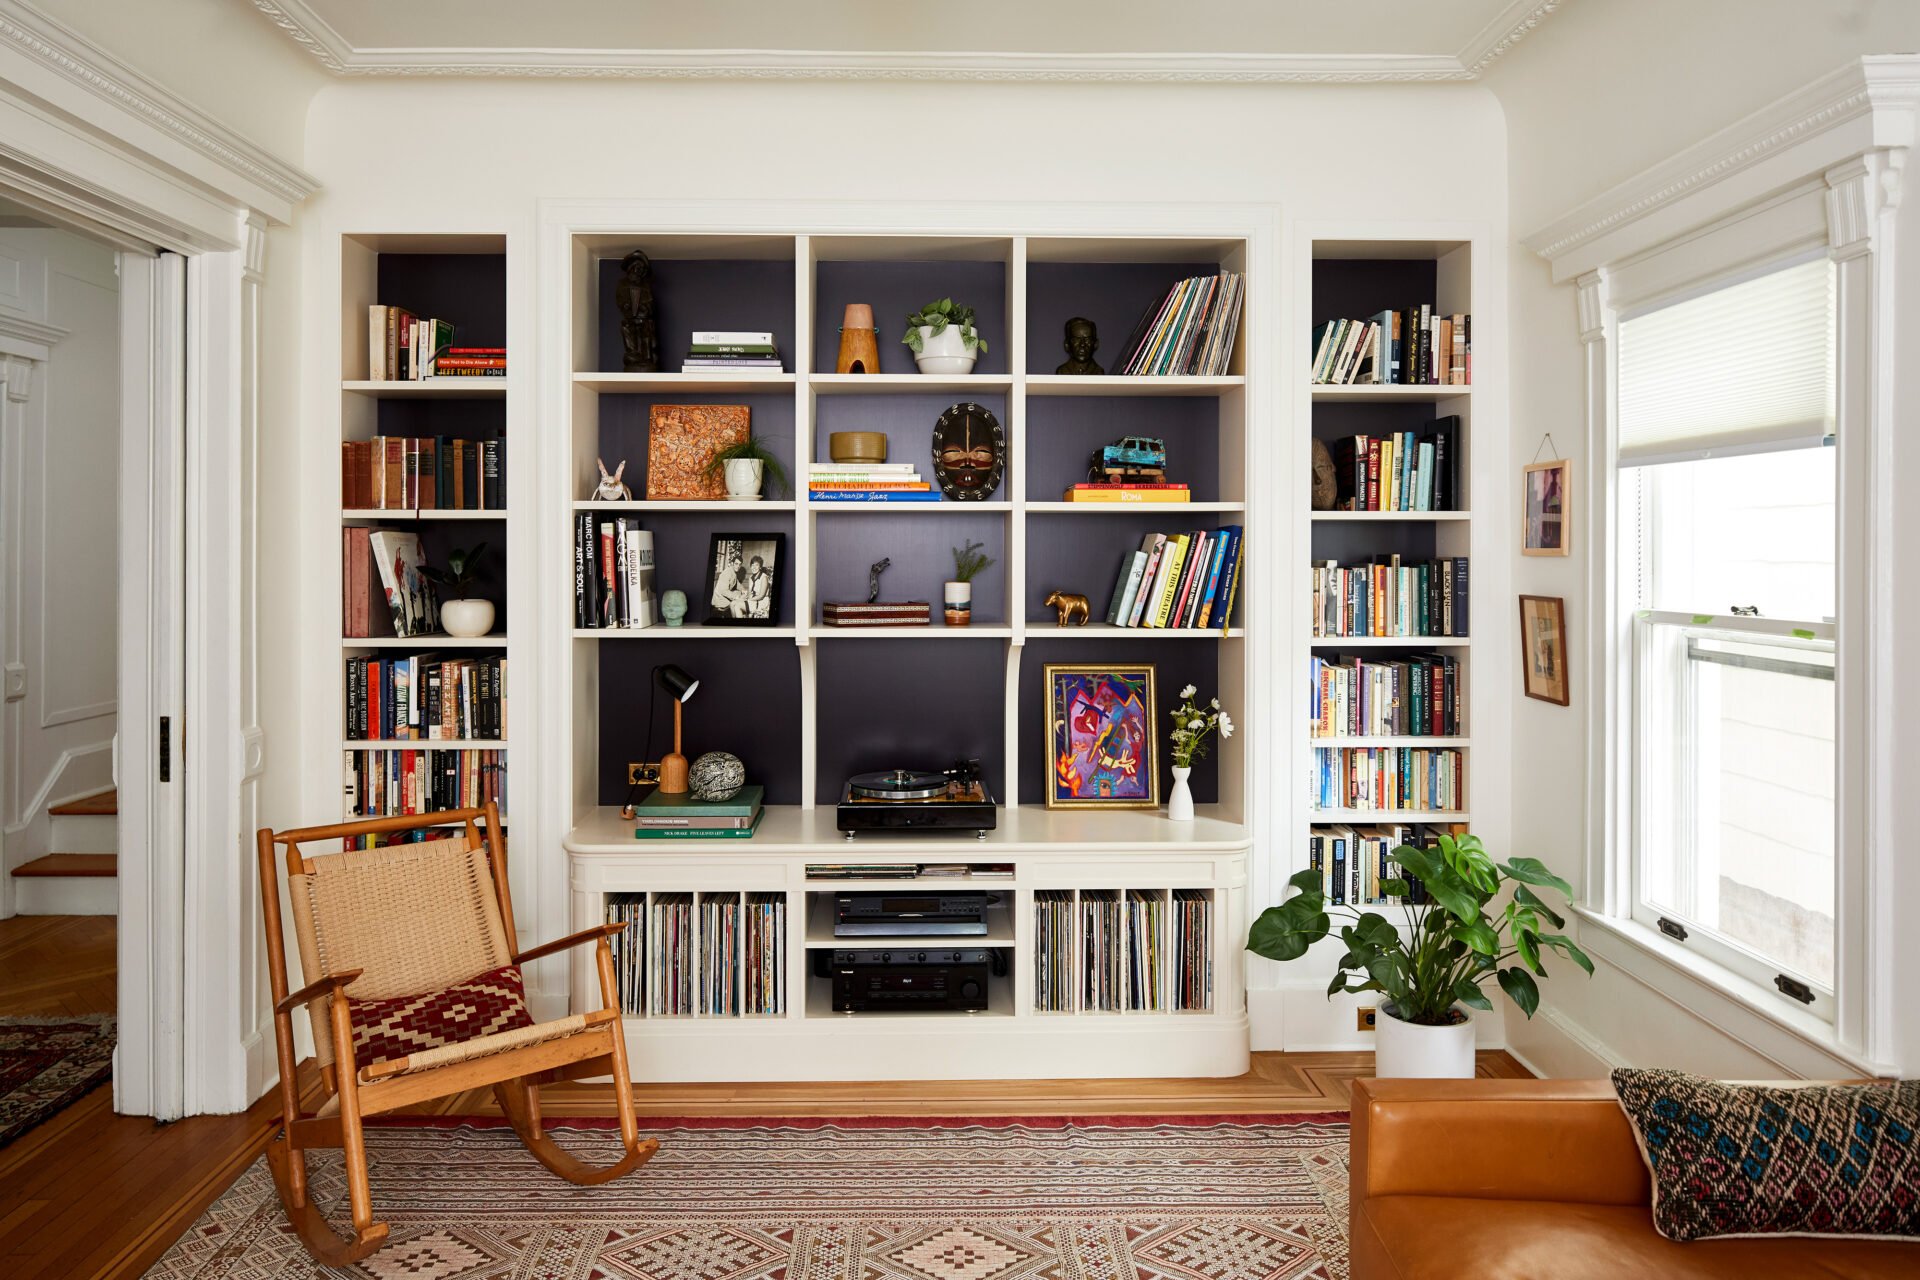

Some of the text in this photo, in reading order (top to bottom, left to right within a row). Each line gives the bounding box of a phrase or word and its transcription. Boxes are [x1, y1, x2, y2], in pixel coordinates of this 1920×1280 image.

[814, 492, 838, 500] Henri
[868, 492, 888, 501] Jazz
[1121, 491, 1142, 501] ROMA
[576, 564, 584, 573] &
[629, 549, 638, 586] KOUDELKA
[576, 573, 584, 596] SOUL
[1159, 561, 1181, 620] AT THIS THEATRE
[396, 704, 407, 729] FRANZEN
[445, 701, 450, 715] AM
